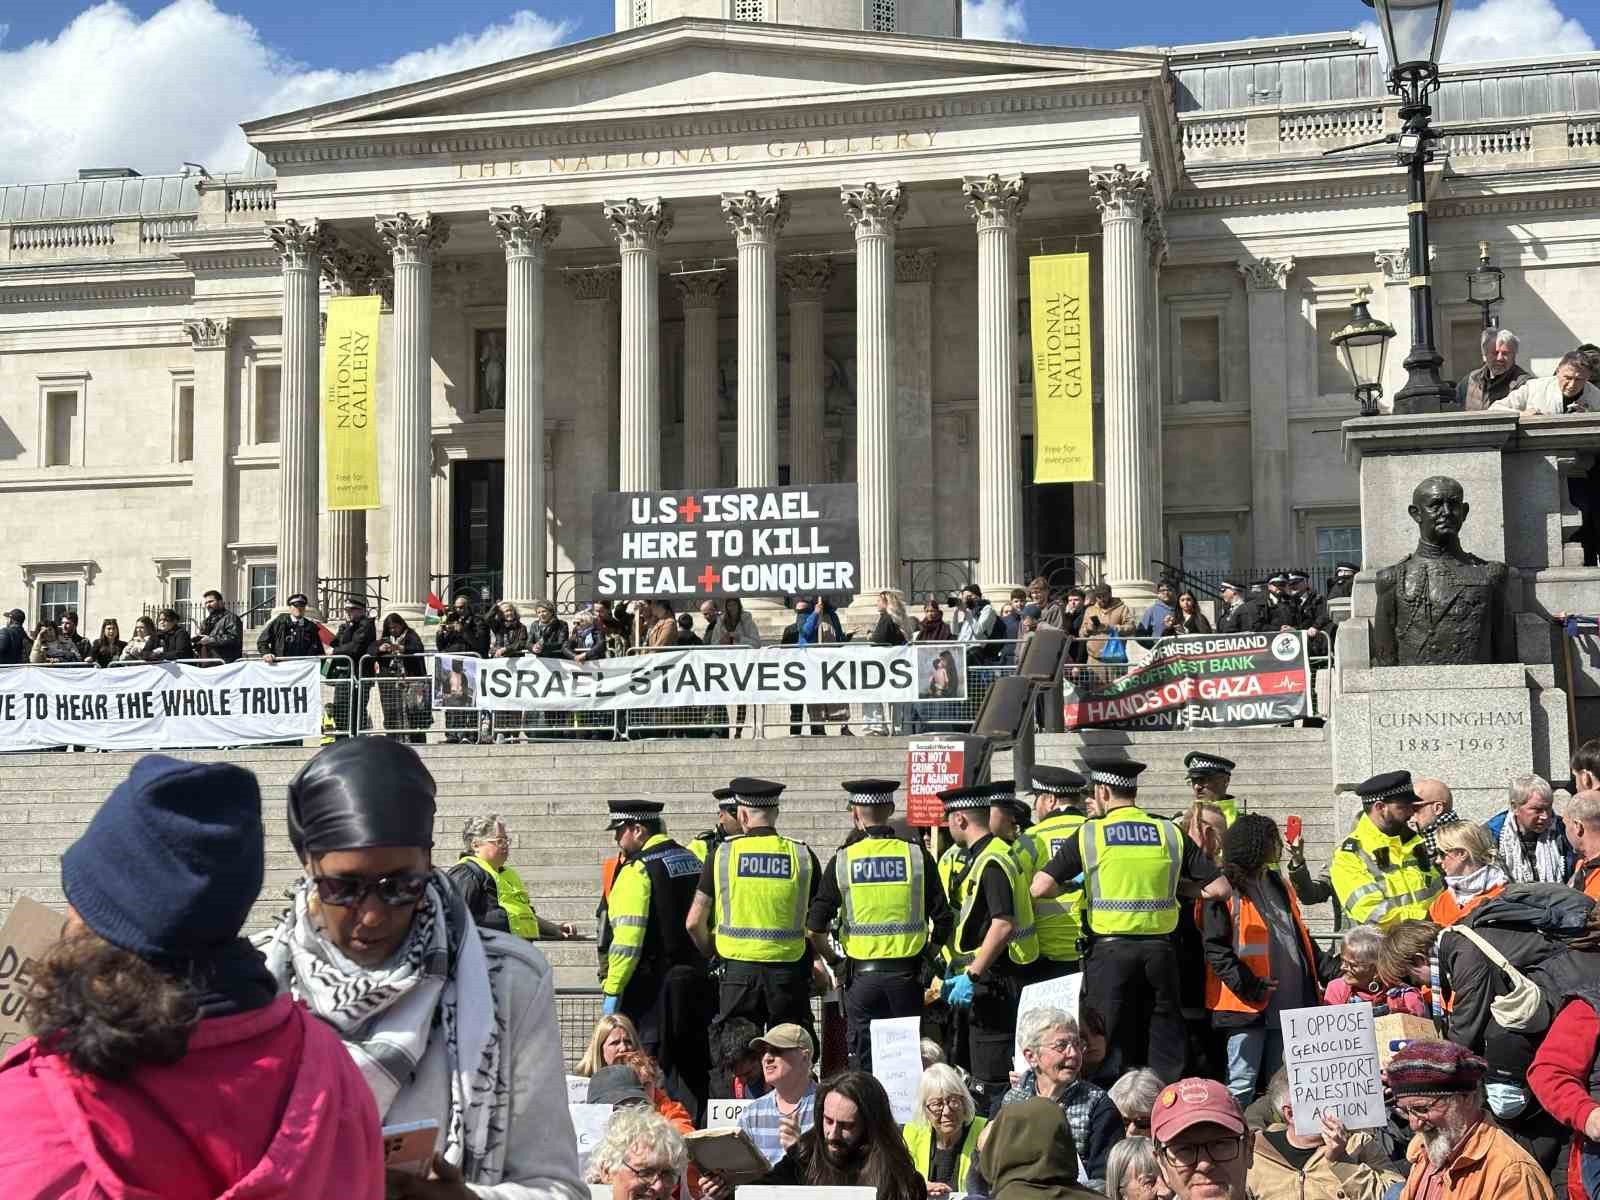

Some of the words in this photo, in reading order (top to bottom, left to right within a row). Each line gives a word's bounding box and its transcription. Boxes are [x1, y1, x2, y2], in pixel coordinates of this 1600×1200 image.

[455, 159, 521, 179] THE
[549, 143, 741, 174] NATIONAL
[767, 128, 938, 158] GALLERY
[1046, 292, 1062, 398] NATIONAL
[1064, 293, 1082, 398] GALLERY
[337, 330, 351, 429] NATIONAL
[352, 331, 370, 429] GALLERY
[622, 531, 697, 560] HERE
[706, 529, 743, 558] TO
[752, 526, 829, 557] KILL
[1205, 635, 1268, 654] DEMAND
[1168, 659, 1206, 677] WEST
[1210, 655, 1255, 673] BANK
[480, 666, 617, 700] ISRAEL
[629, 659, 807, 695] STARVES
[821, 657, 913, 691] KIDS
[24, 693, 48, 720] TO
[56, 694, 108, 720] HEAR
[116, 691, 153, 719] THE
[161, 688, 233, 718] WHOLE
[239, 686, 308, 715] TRUTH
[1088, 689, 1164, 722] HANDS
[1200, 675, 1263, 699] GAZA
[1227, 702, 1274, 721] NOW
[1378, 711, 1524, 728] CUNNINGHAM
[911, 763, 934, 773] CRIME
[936, 763, 948, 773] TO
[928, 752, 943, 762] NOT
[944, 752, 951, 762] A
[911, 774, 925, 785] ACT
[927, 774, 959, 785] AGAINST
[1107, 824, 1159, 843] POLICE
[739, 856, 791, 876] POLICE
[853, 860, 905, 880] POLICE
[1289, 1019, 1297, 1038] I
[1307, 1012, 1369, 1036] OPPOSE
[1291, 1037, 1362, 1058] GENOCIDE
[1294, 1068, 1302, 1086] I
[1310, 1057, 1375, 1083] SUPPORT
[1295, 1078, 1378, 1103] PALESTINE
[712, 1105, 719, 1120] I
[1312, 1101, 1368, 1121] ACTION
